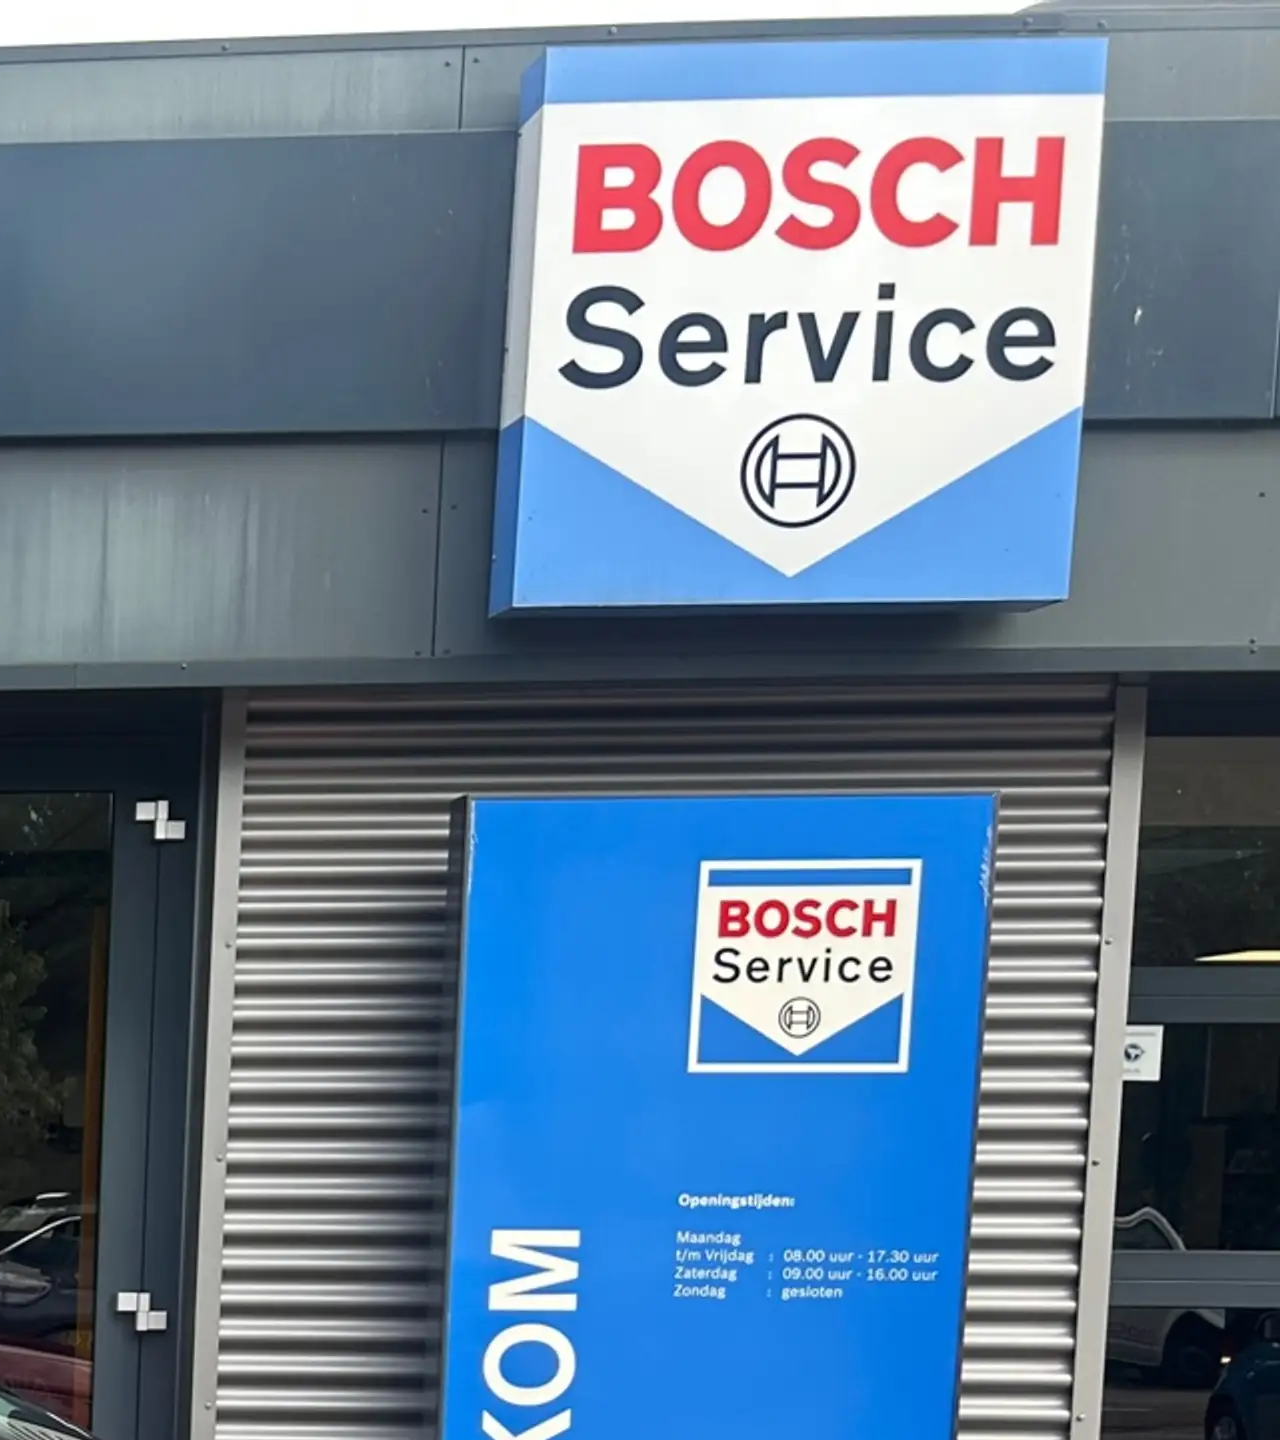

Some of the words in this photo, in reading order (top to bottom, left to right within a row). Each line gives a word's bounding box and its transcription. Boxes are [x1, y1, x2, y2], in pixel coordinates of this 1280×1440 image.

[571, 136, 1066, 254] BOSCH
[558, 282, 1057, 390] Service
[717, 898, 898, 939] BOSCH
[712, 947, 894, 984] Service
[678, 1193, 795, 1209] Openingstijden:
[676, 1230, 741, 1246] Maandag
[675, 1249, 701, 1263] t/m
[705, 1249, 754, 1264] Vrijdag
[783, 1250, 825, 1263] 08.00
[828, 1252, 854, 1263] uur
[866, 1250, 909, 1264] 17.30
[913, 1253, 939, 1264] uur
[674, 1266, 738, 1282] Zaterdag
[782, 1267, 824, 1281] 09.00
[828, 1270, 853, 1281] uur
[866, 1268, 908, 1281] 16.00
[912, 1270, 938, 1281] uur
[673, 1284, 726, 1299] Zondag
[781, 1285, 843, 1300] gesloten
